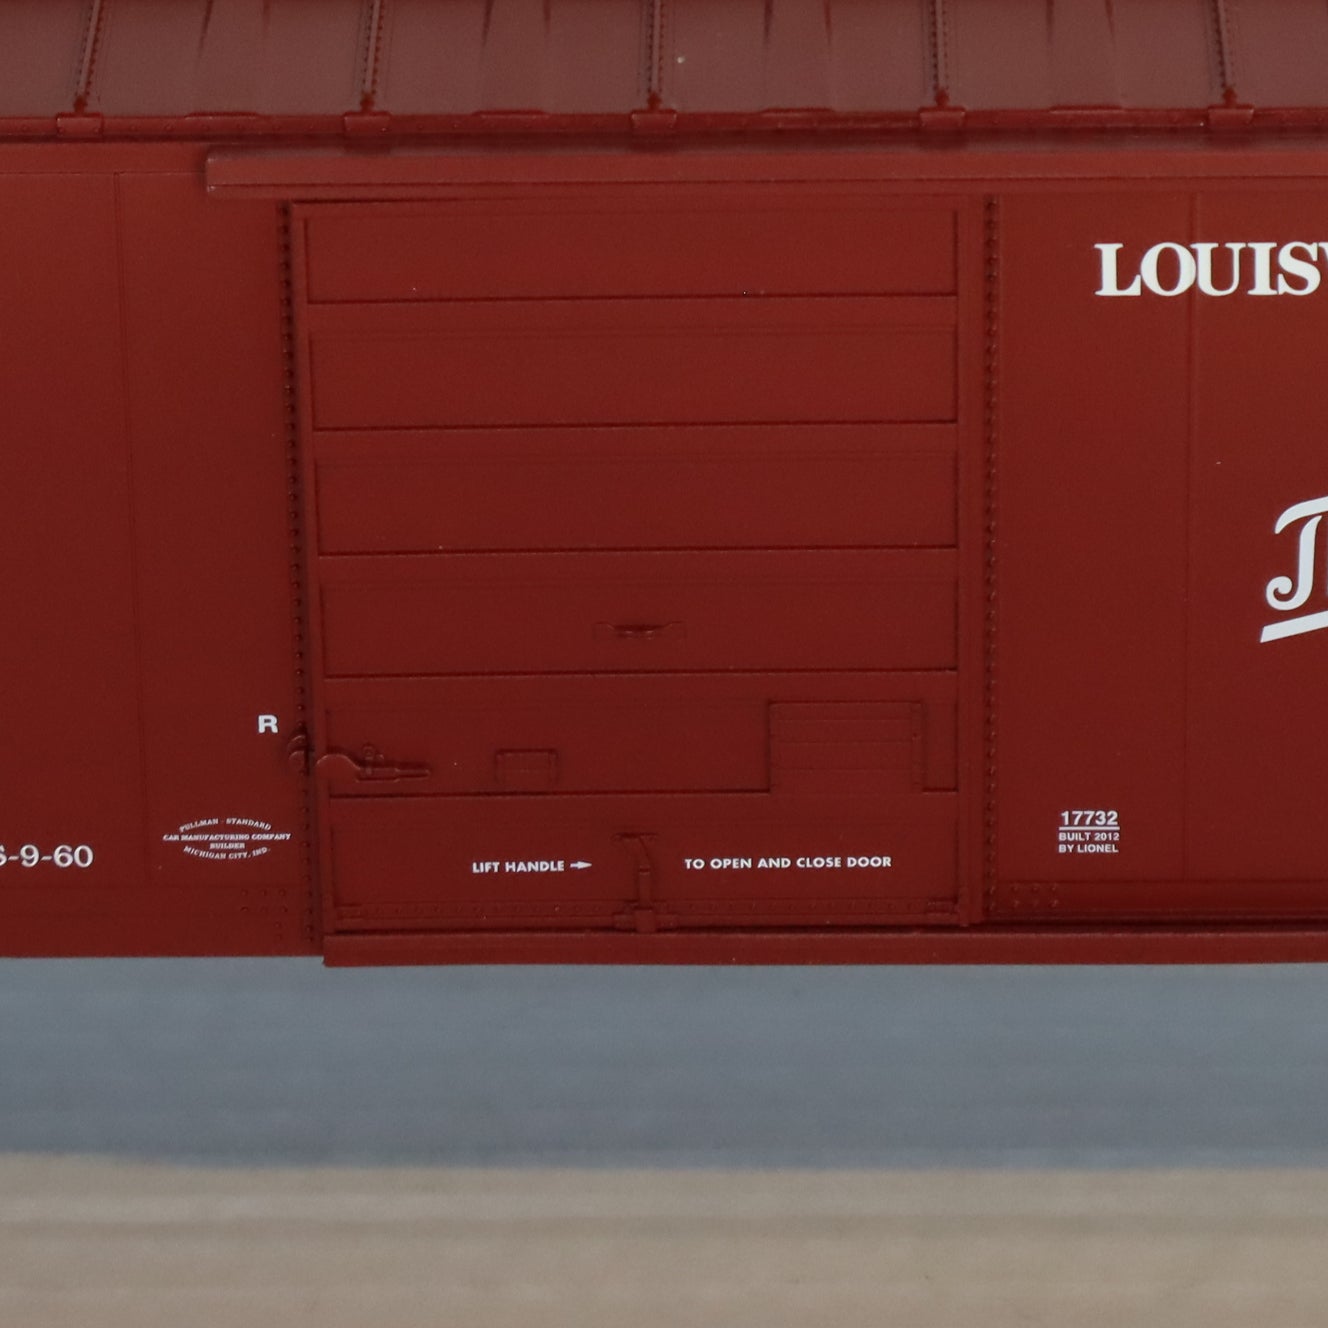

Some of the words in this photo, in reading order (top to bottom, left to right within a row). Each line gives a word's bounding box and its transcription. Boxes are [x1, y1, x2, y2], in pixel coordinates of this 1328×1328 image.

[258, 715, 278, 733] R
[1060, 810, 1119, 825] 17732
[179, 818, 219, 833] PULLMAN
[226, 817, 272, 831] STANDARD
[181, 833, 250, 841] MANUFACTURING
[251, 833, 291, 841] COMPANY
[1059, 832, 1091, 841] BUILT
[1094, 832, 1119, 841] 2012
[183, 845, 226, 859] MICHIGAN
[1059, 844, 1074, 853] BY
[1077, 844, 1118, 853] LIONEL
[473, 862, 500, 873] LIFT
[505, 861, 564, 872] HANDLE
[685, 859, 705, 869] TO
[710, 858, 752, 869] OPEN
[758, 858, 791, 868] AND
[796, 857, 841, 868] CLOSE
[847, 856, 891, 867] DOOR
